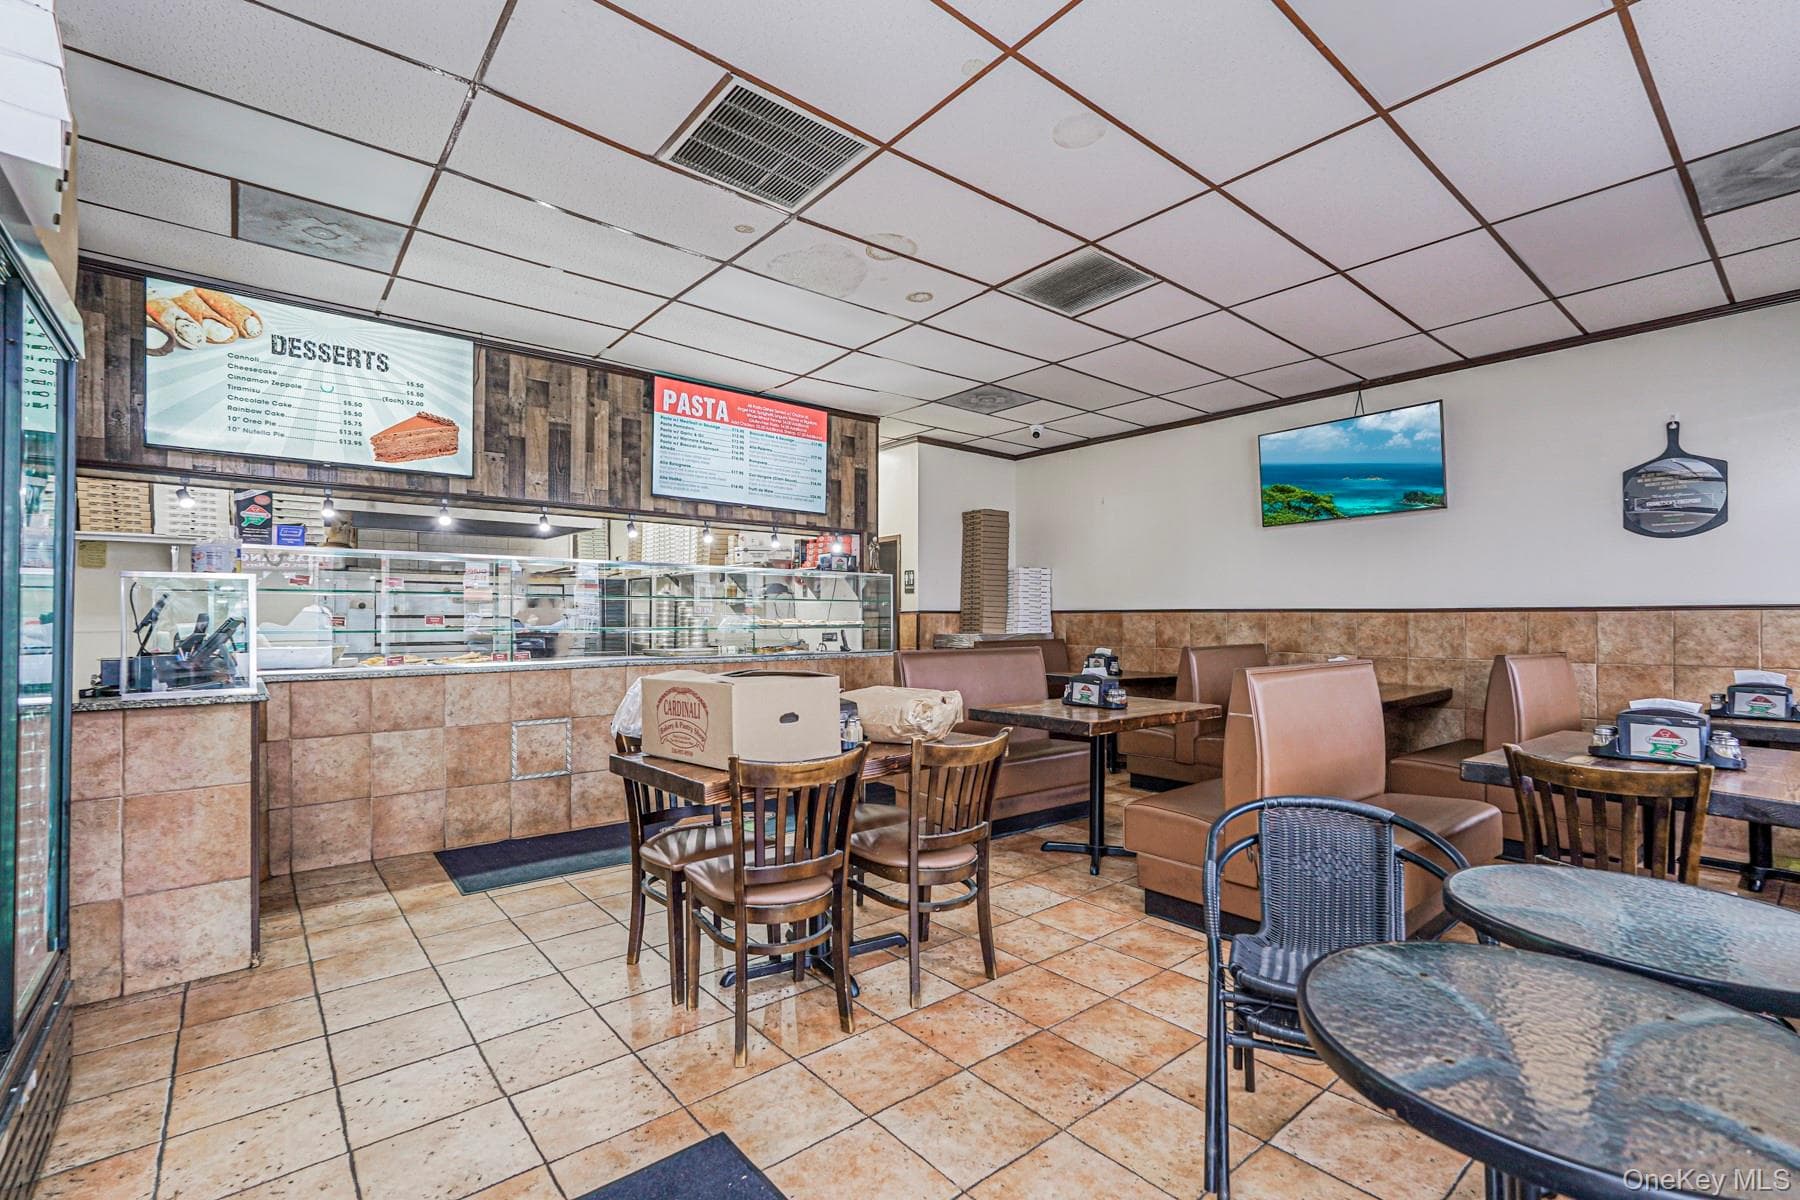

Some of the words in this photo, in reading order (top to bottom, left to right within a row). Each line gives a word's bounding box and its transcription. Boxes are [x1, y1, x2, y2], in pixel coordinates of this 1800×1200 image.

[271, 334, 389, 373] DESSERTS
[227, 373, 269, 384] Cinnamon
[271, 380, 302, 390] Zeppole
[228, 363, 277, 376] Cheesecake
[406, 390, 424, 398] $5.50
[407, 381, 424, 389] $5.50
[227, 384, 260, 393] Tiramisu
[344, 400, 362, 408] $5.50
[227, 394, 269, 405] Chocolate
[272, 400, 292, 408] Cake
[227, 405, 262, 414] Rainbow
[663, 388, 729, 422] PASTA
[243, 428, 271, 436] Nutella
[339, 429, 362, 437] $13.95
[664, 699, 700, 719] CARDINALI
